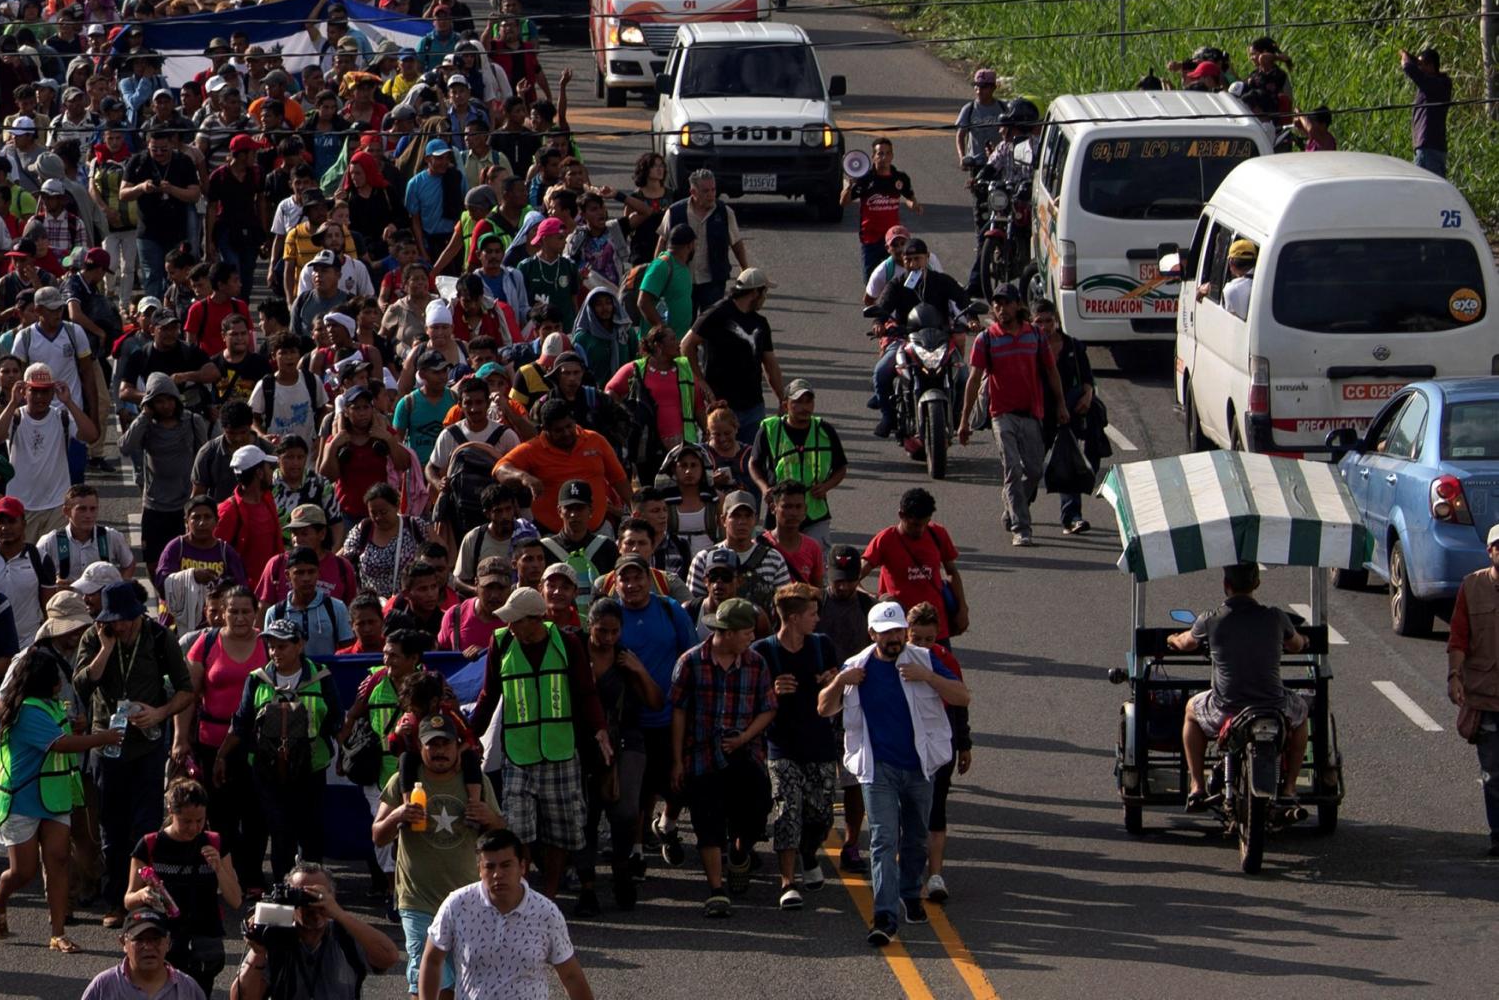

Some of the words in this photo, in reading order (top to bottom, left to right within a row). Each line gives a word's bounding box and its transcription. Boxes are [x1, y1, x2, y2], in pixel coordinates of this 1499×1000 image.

[1441, 210, 1461, 228] 25
[1086, 299, 1143, 313] PRECAUCION
[1345, 386, 1365, 398] CC
